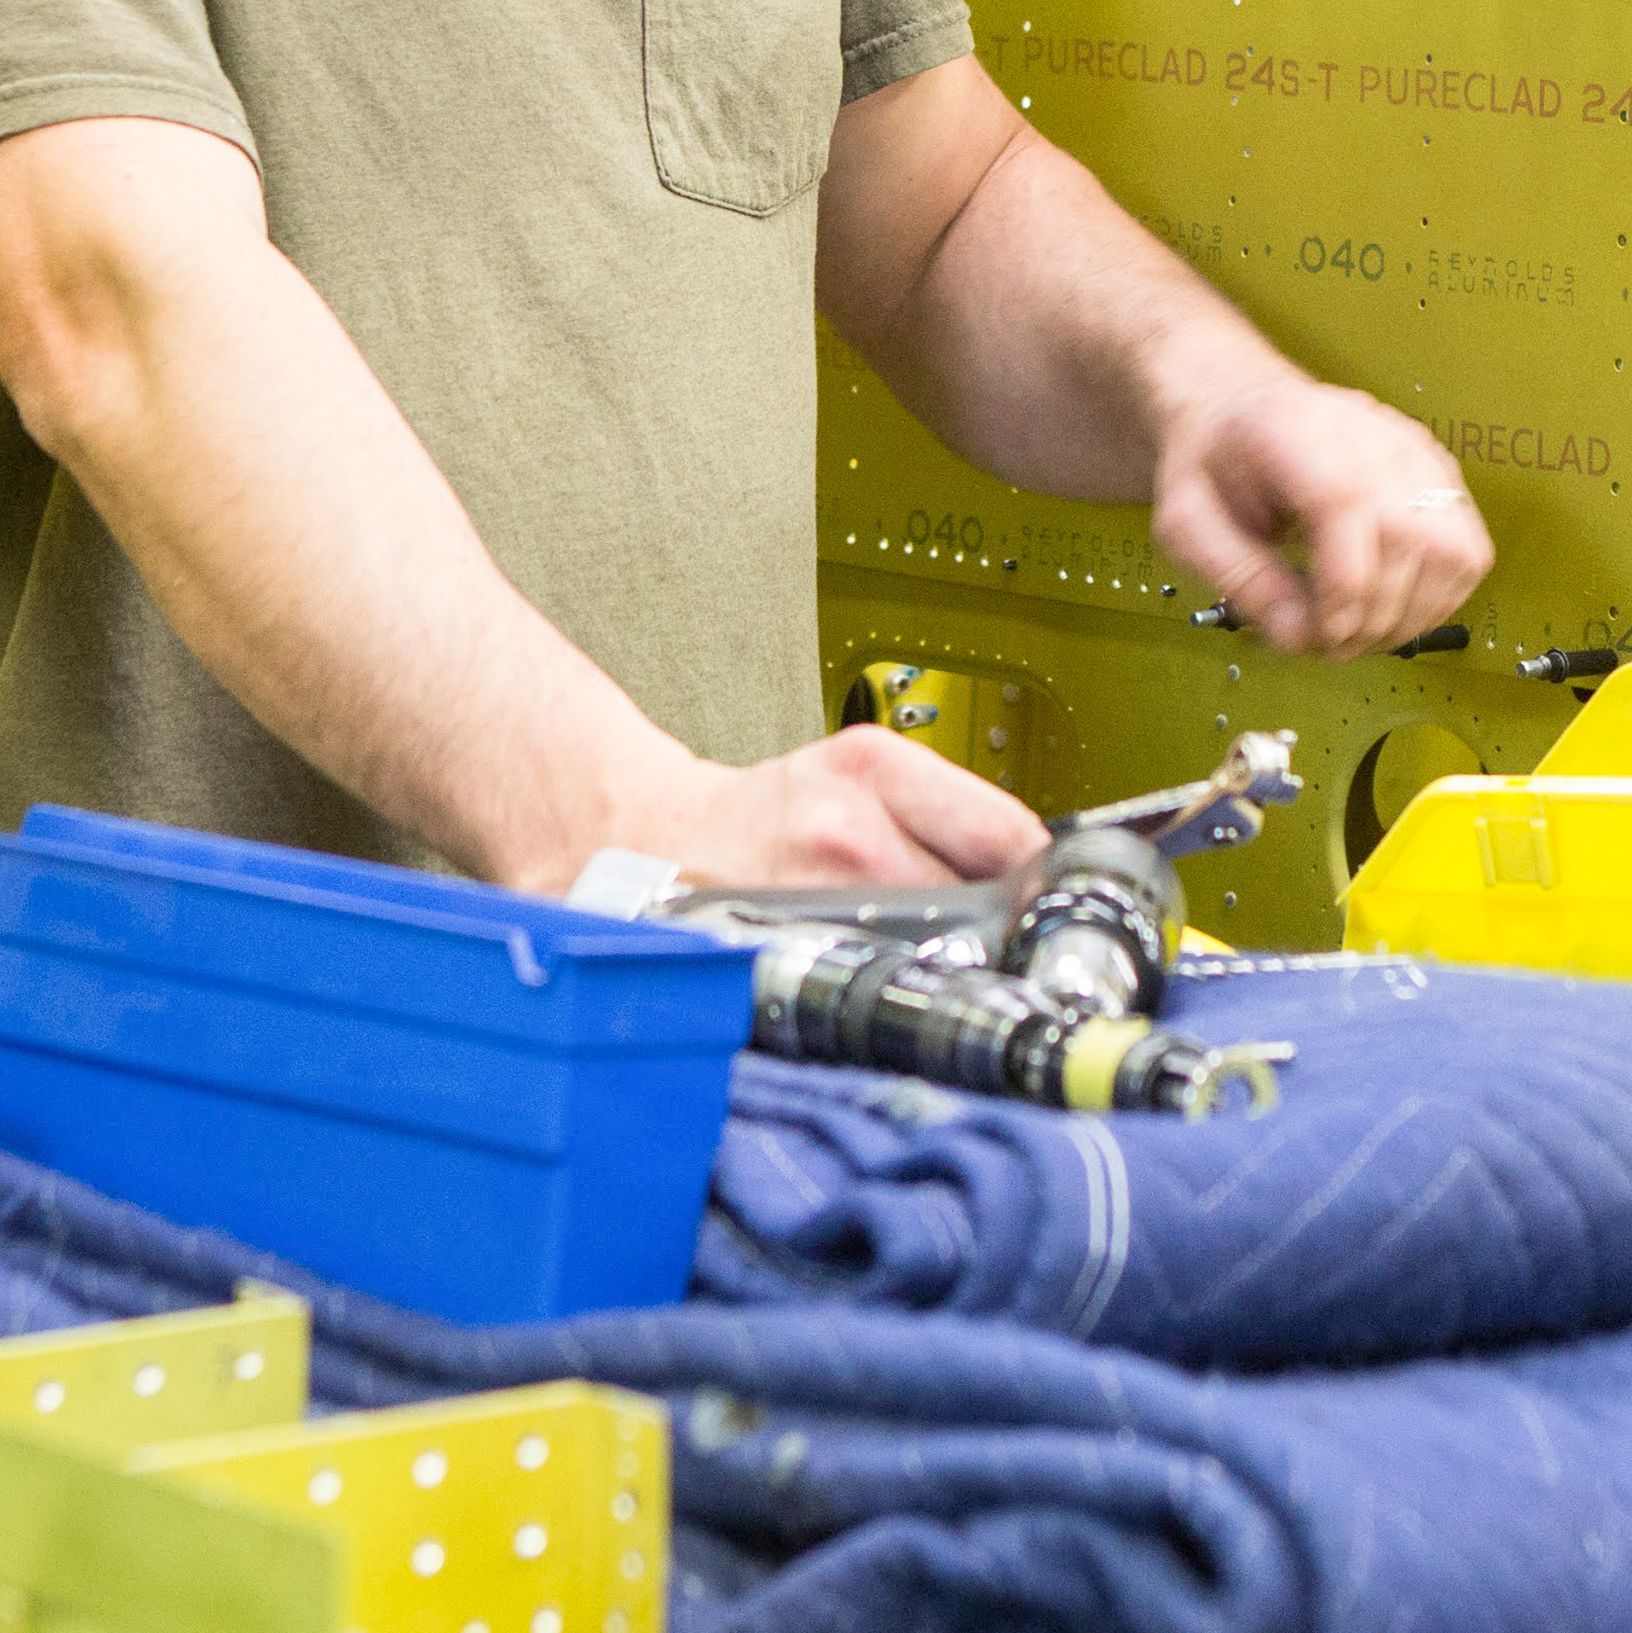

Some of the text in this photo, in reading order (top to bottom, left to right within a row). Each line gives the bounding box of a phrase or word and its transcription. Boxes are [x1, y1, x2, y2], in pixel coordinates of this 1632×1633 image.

[1022, 35, 1208, 86] PURECLAD
[1223, 52, 1340, 102] 24S-T
[1358, 65, 1563, 119] PURECLAD
[1294, 236, 1386, 282] .040
